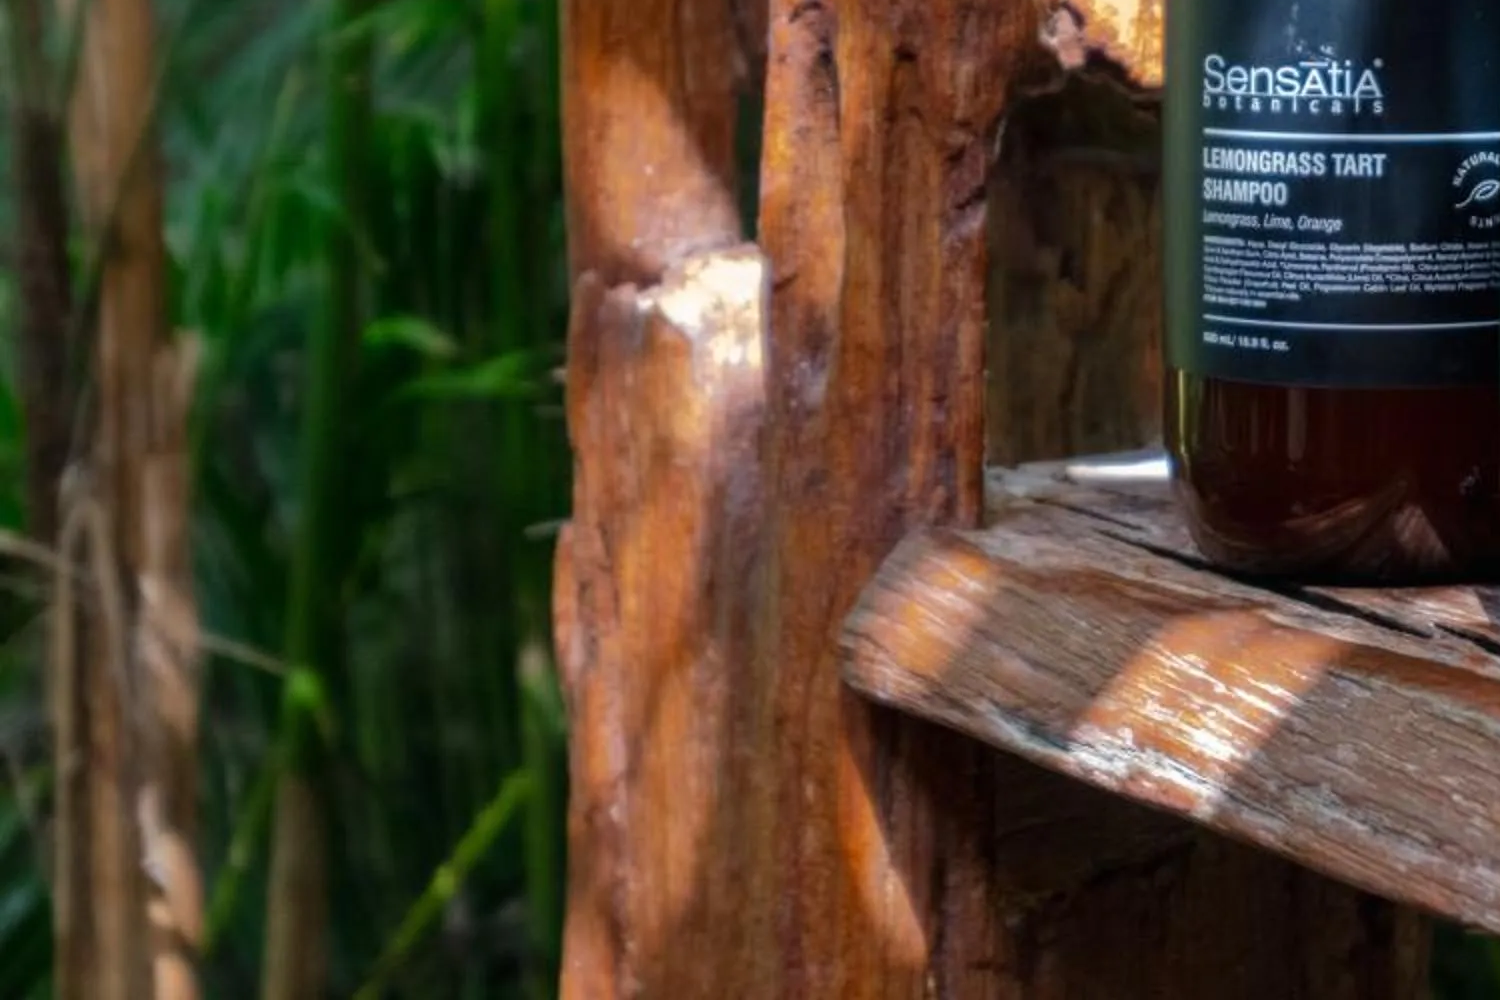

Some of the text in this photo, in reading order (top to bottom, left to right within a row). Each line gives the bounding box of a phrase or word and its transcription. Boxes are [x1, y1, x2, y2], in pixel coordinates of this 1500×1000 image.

[1203, 89, 1383, 114] botanicals
[1203, 147, 1387, 178] LEMONGRASS TART
[1203, 177, 1288, 206] SHAMPOO
[1297, 214, 1343, 234] Orange
